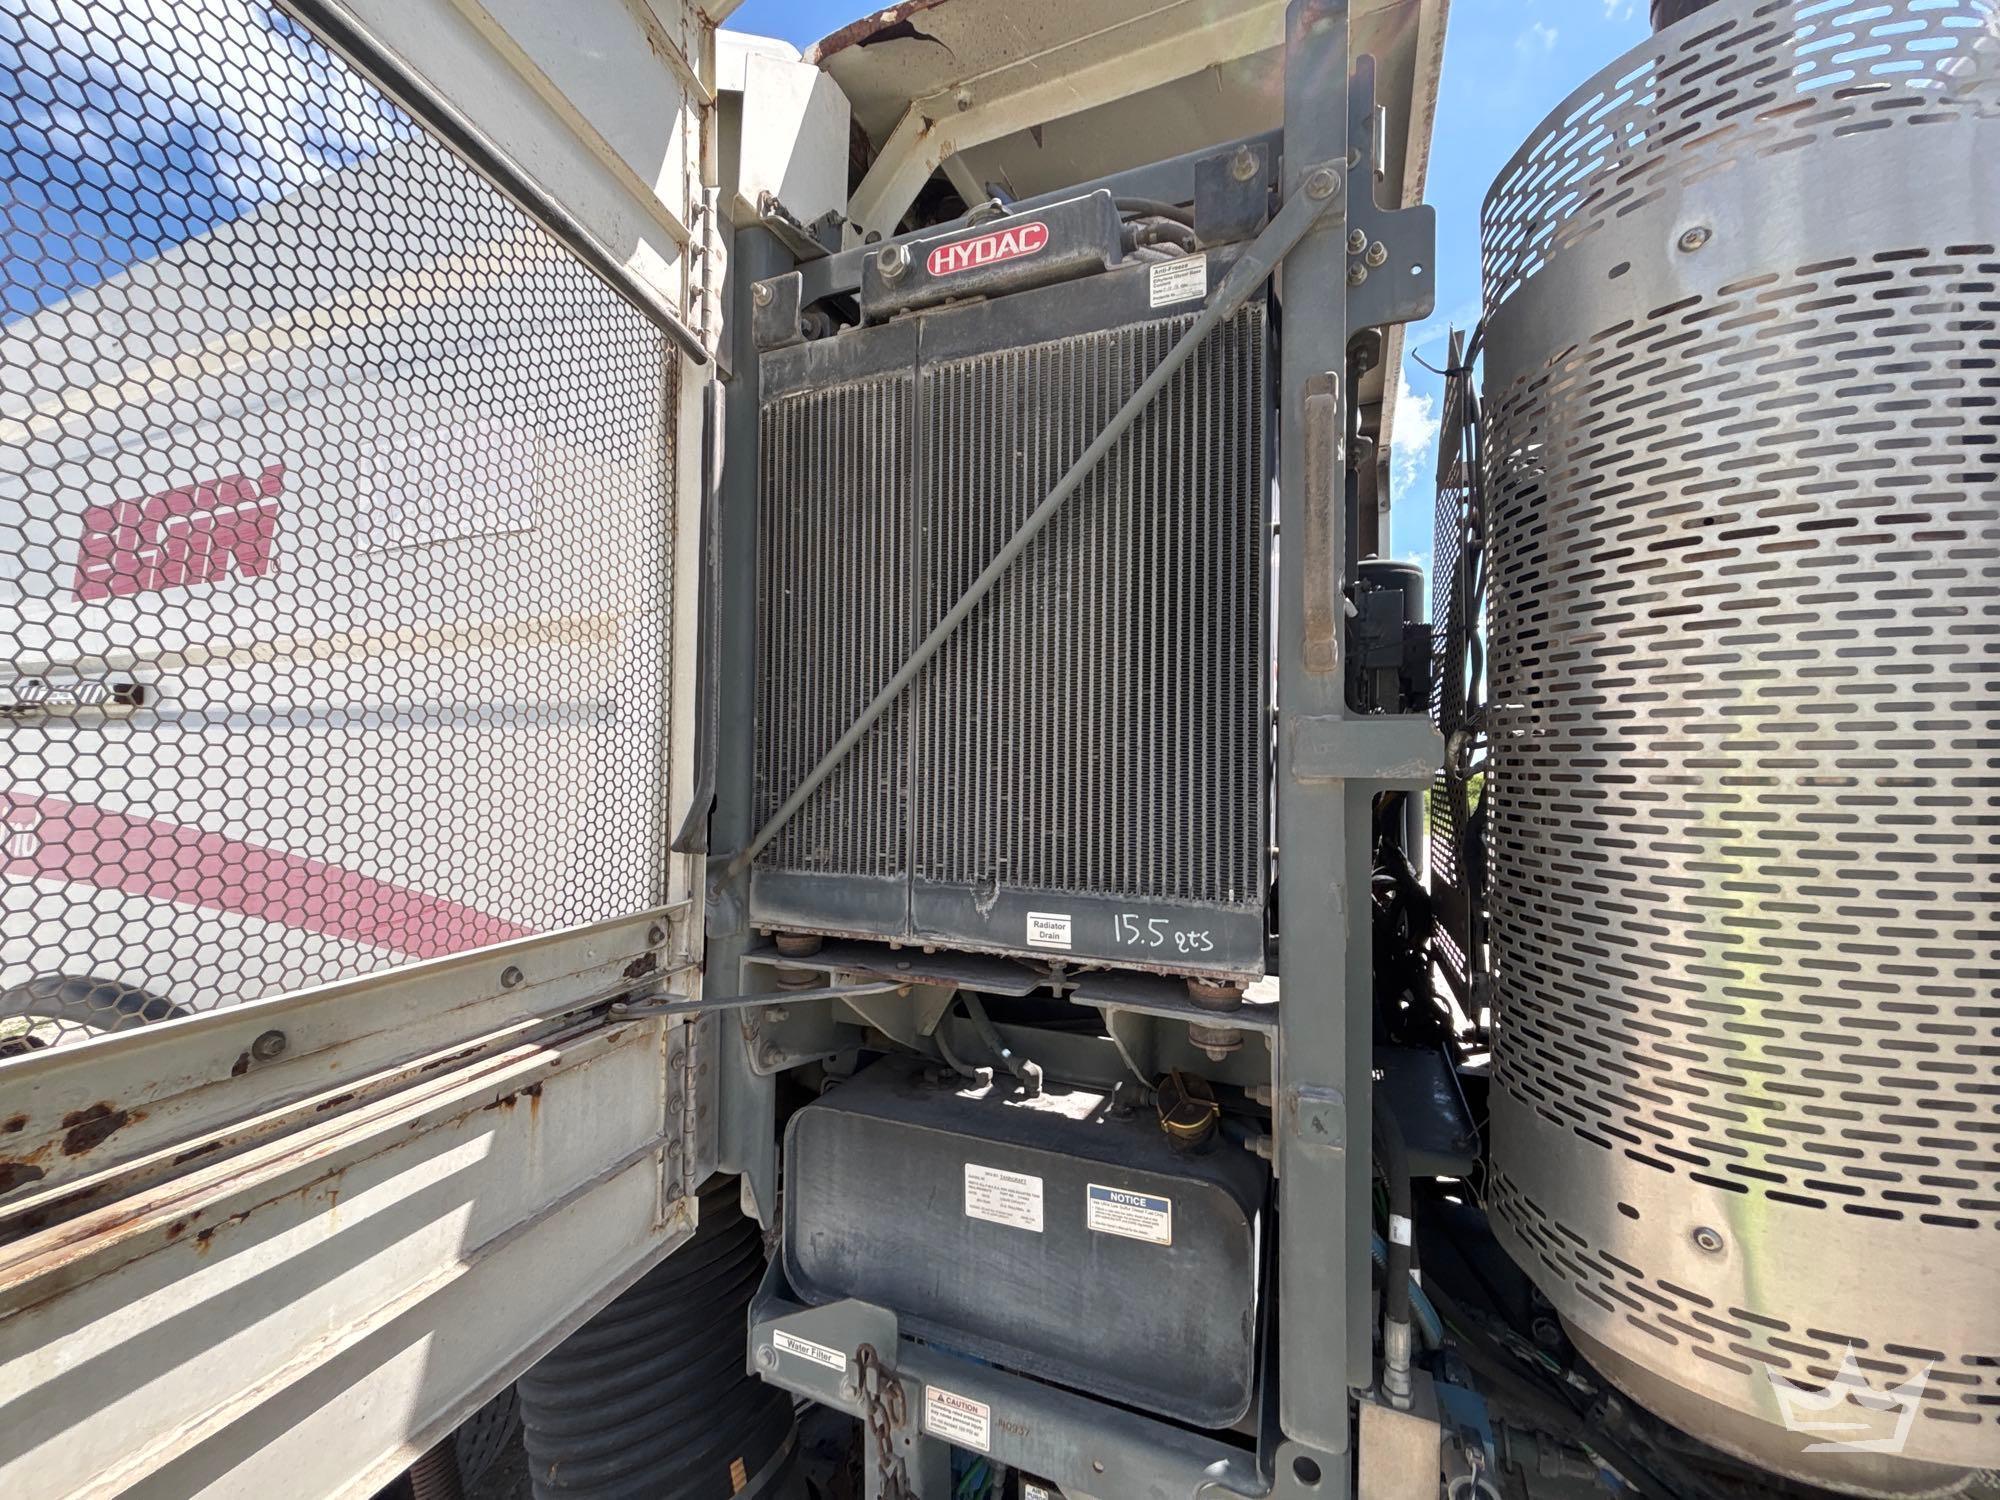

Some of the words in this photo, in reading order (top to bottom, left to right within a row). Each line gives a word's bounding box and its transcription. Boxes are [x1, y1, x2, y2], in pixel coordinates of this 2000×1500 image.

[934, 225, 1041, 273] HYDAC
[1154, 263, 1189, 275] Anti-Freeze
[1033, 920, 1067, 931] Radiator
[1115, 913, 1169, 947] 15.5
[1039, 931, 1060, 941] Drain
[1110, 1192, 1147, 1207] NOTICE
[787, 1339, 810, 1353] Water
[811, 1347, 832, 1362] Filter
[946, 1396, 978, 1414] CAUTION
